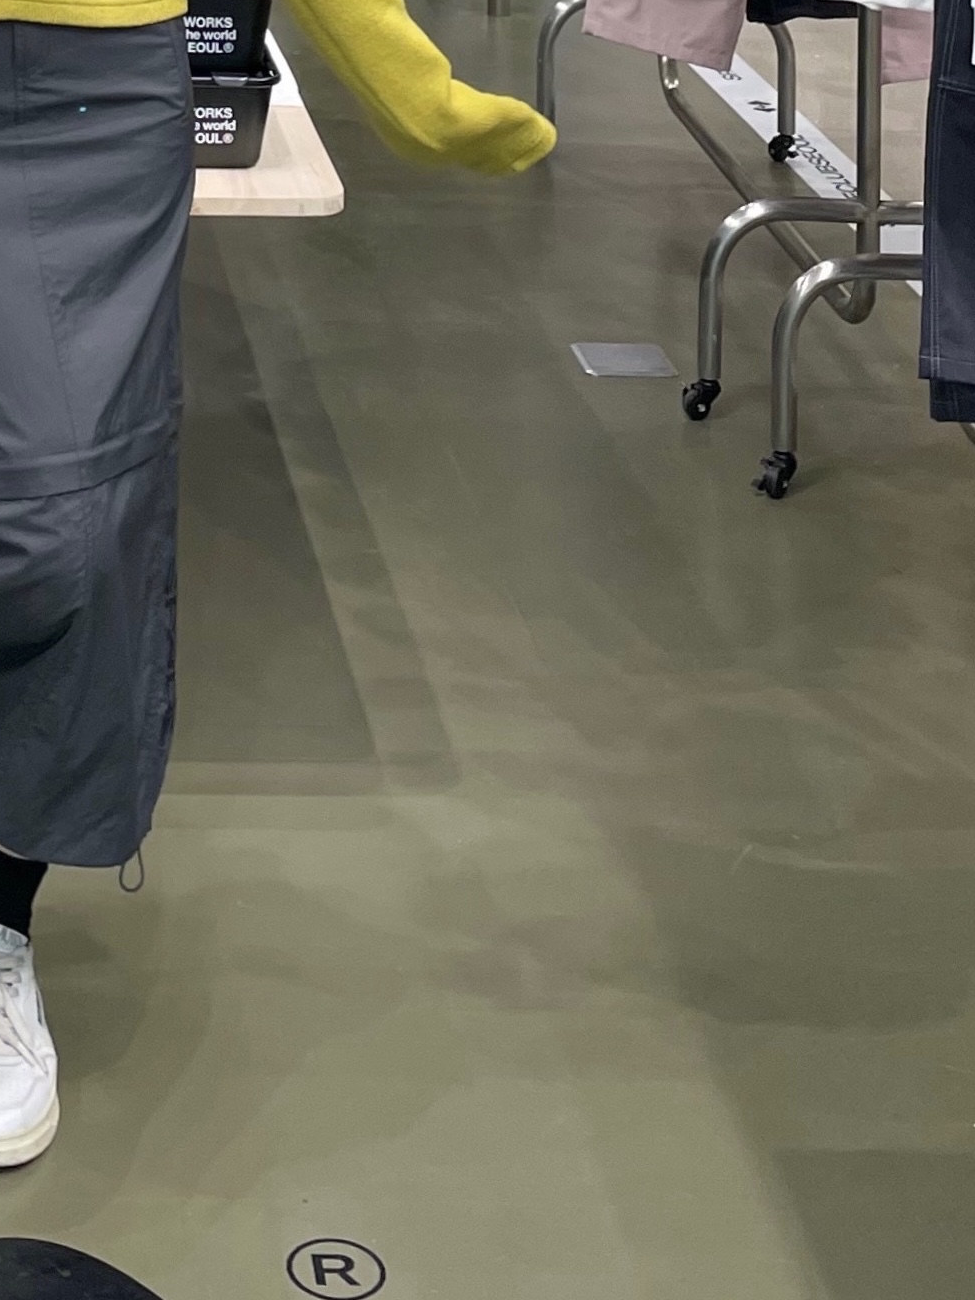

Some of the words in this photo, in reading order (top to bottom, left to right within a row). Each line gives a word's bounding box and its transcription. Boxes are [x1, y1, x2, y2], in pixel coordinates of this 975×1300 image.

[183, 16, 233, 28] WORKS
[203, 29, 237, 40] world
[193, 107, 233, 119] ORKS
[203, 120, 236, 131] world
